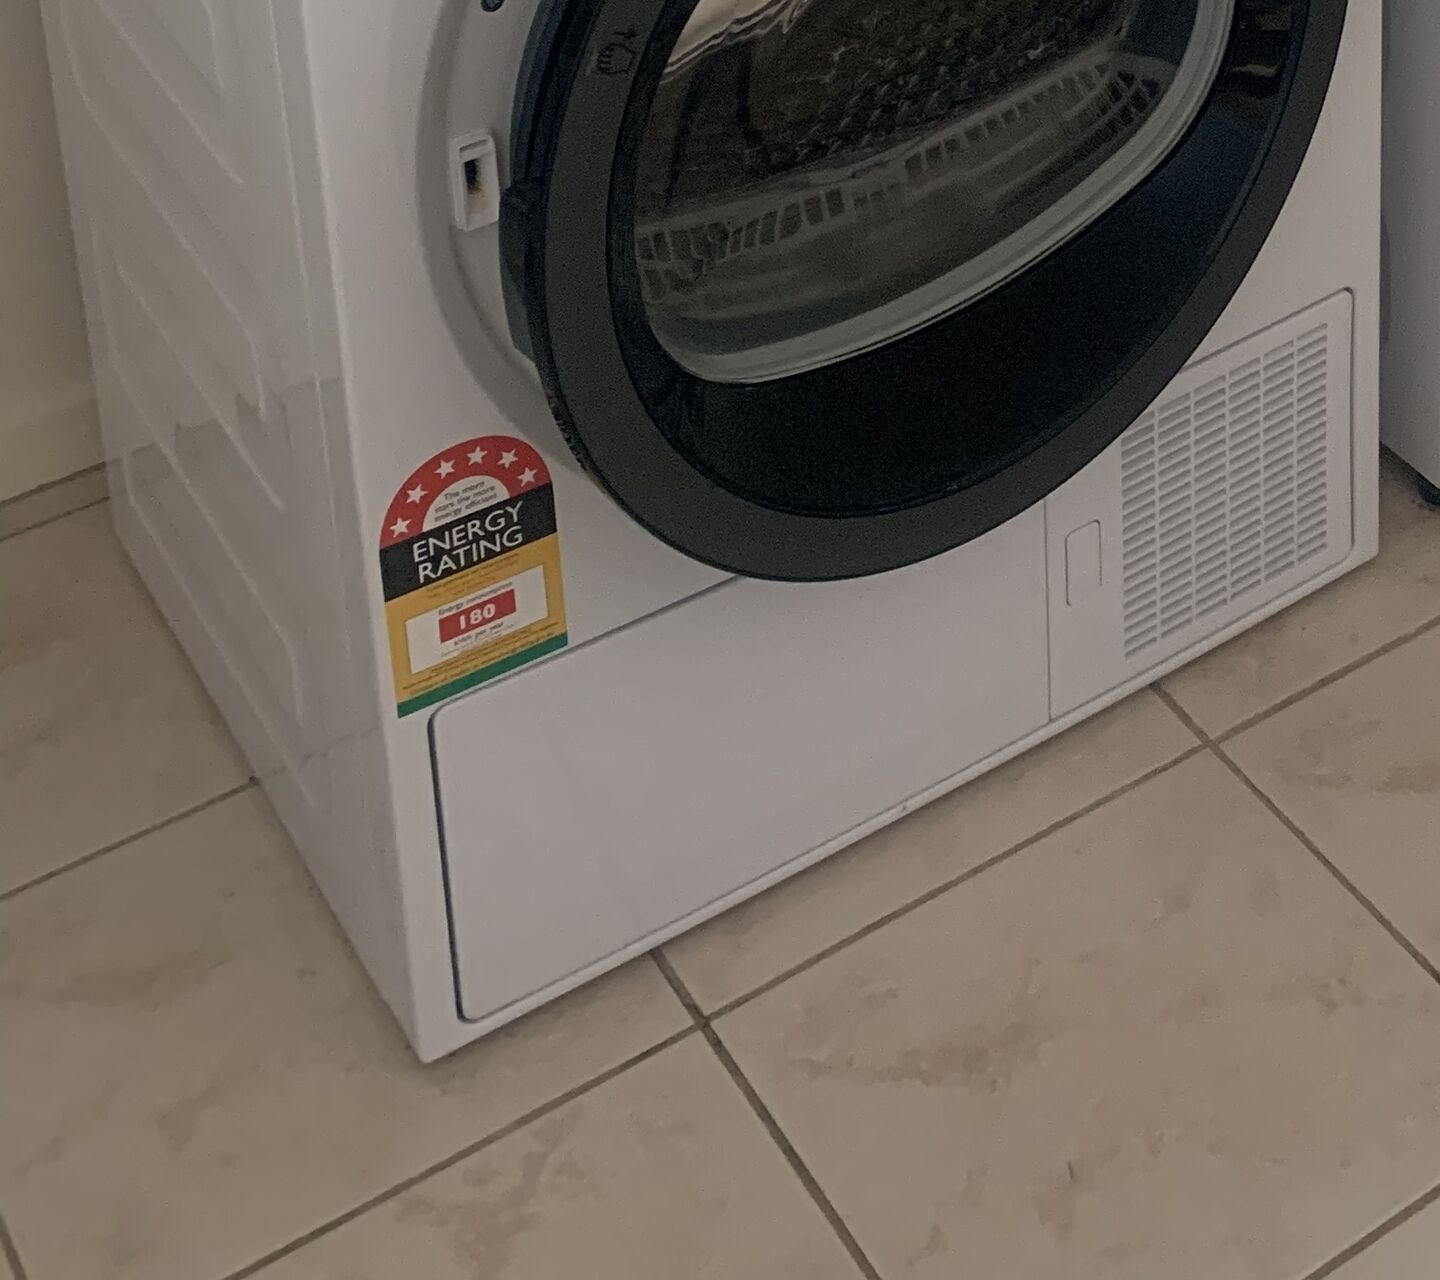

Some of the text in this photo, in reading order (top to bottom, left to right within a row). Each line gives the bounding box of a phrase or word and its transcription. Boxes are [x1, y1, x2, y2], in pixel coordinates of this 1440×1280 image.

[412, 500, 523, 562] ENERGY
[417, 525, 523, 584] RATING
[458, 604, 496, 629] 180
